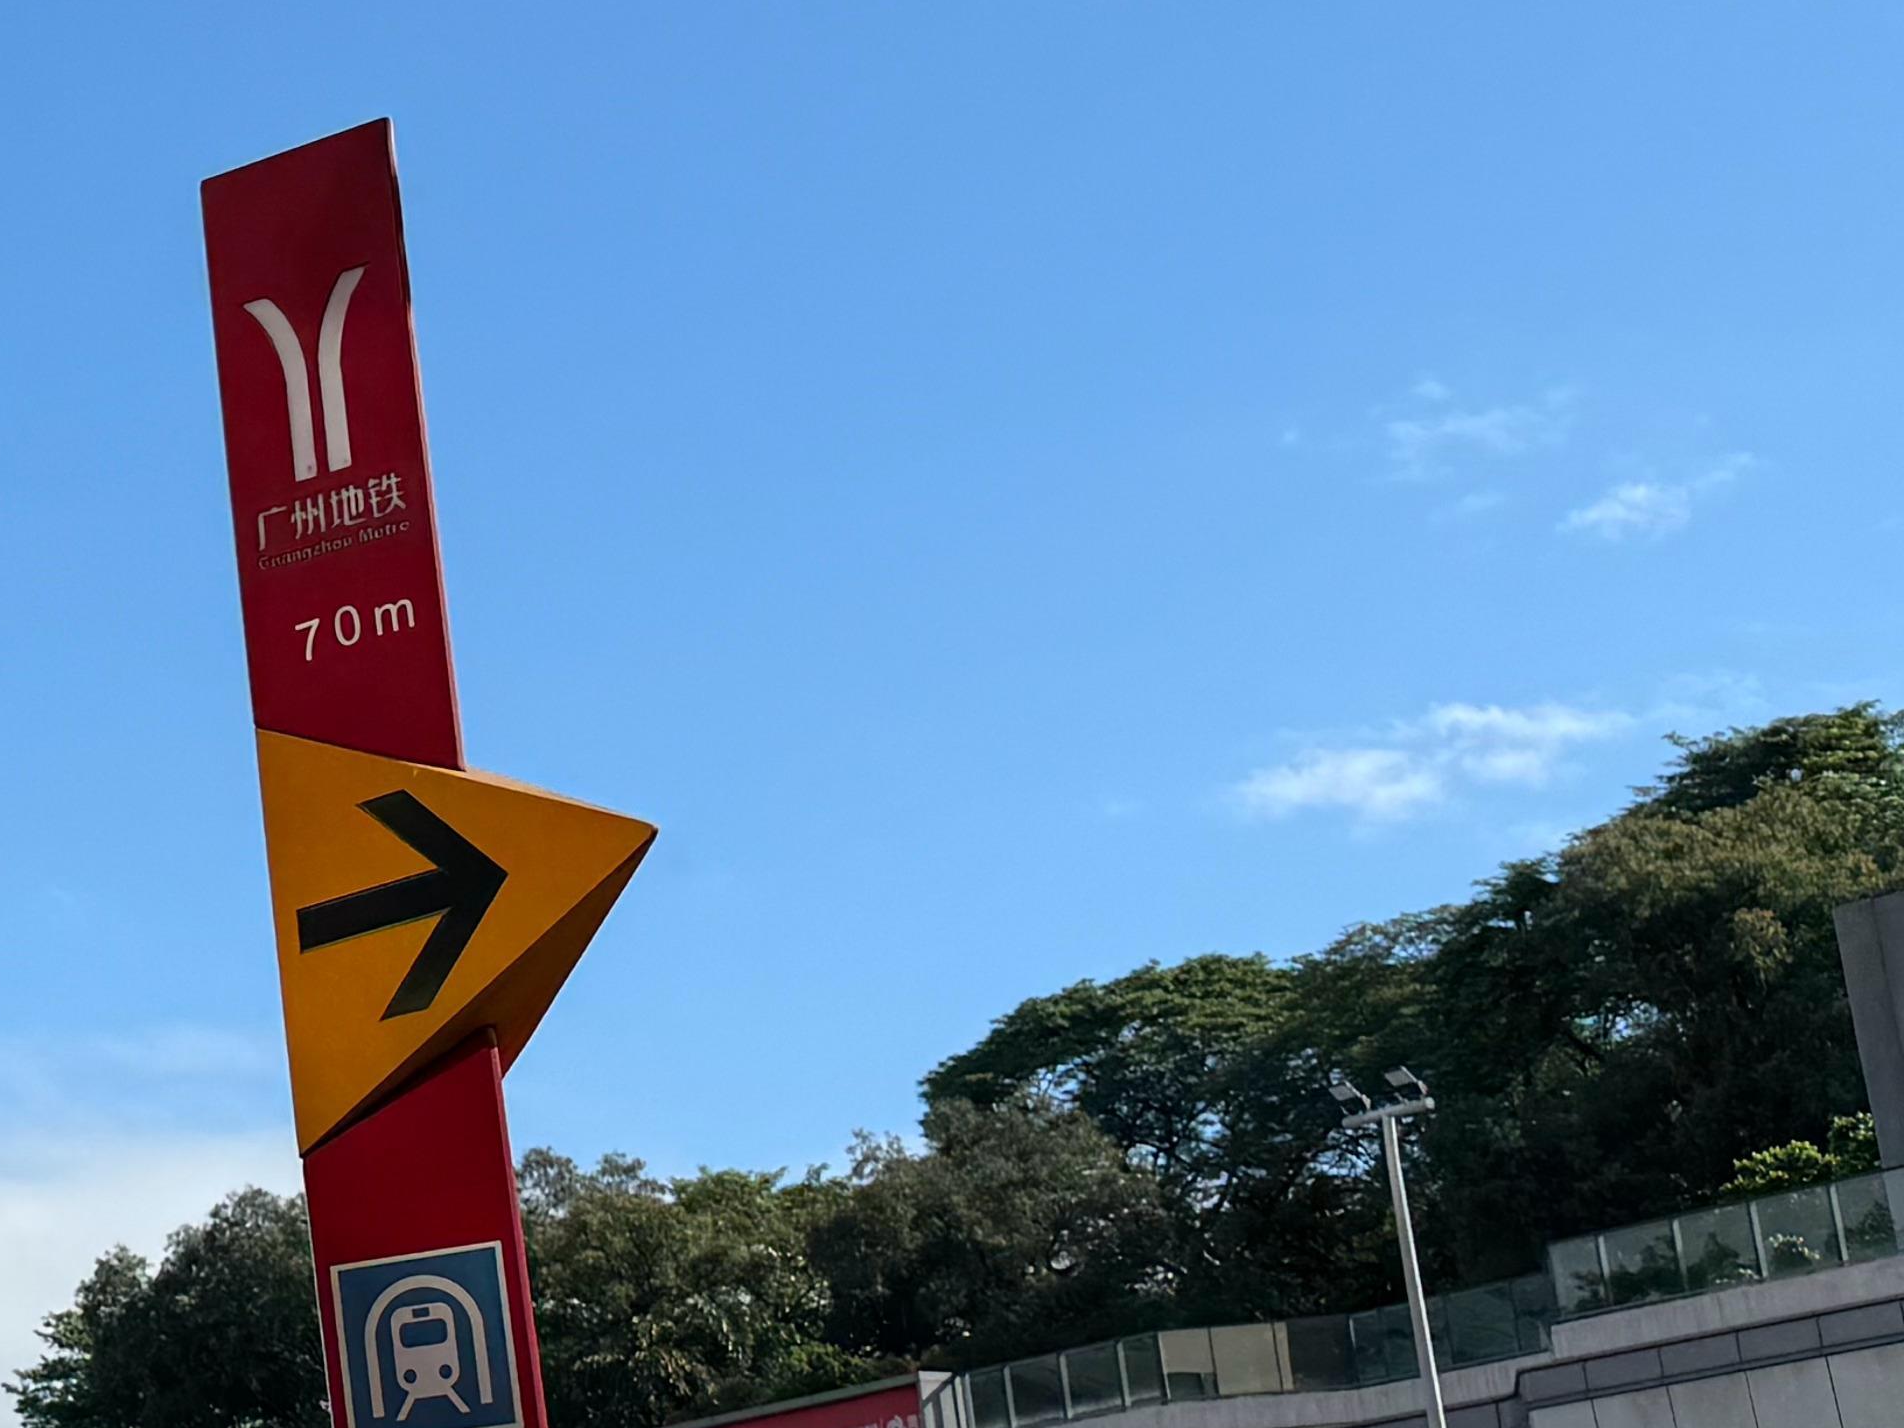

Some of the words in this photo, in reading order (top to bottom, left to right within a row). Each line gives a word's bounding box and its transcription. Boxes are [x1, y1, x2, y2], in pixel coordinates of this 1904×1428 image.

[257, 472, 407, 551] 广州地铁
[258, 535, 353, 570] Guangzhou
[294, 598, 415, 661] 70m
